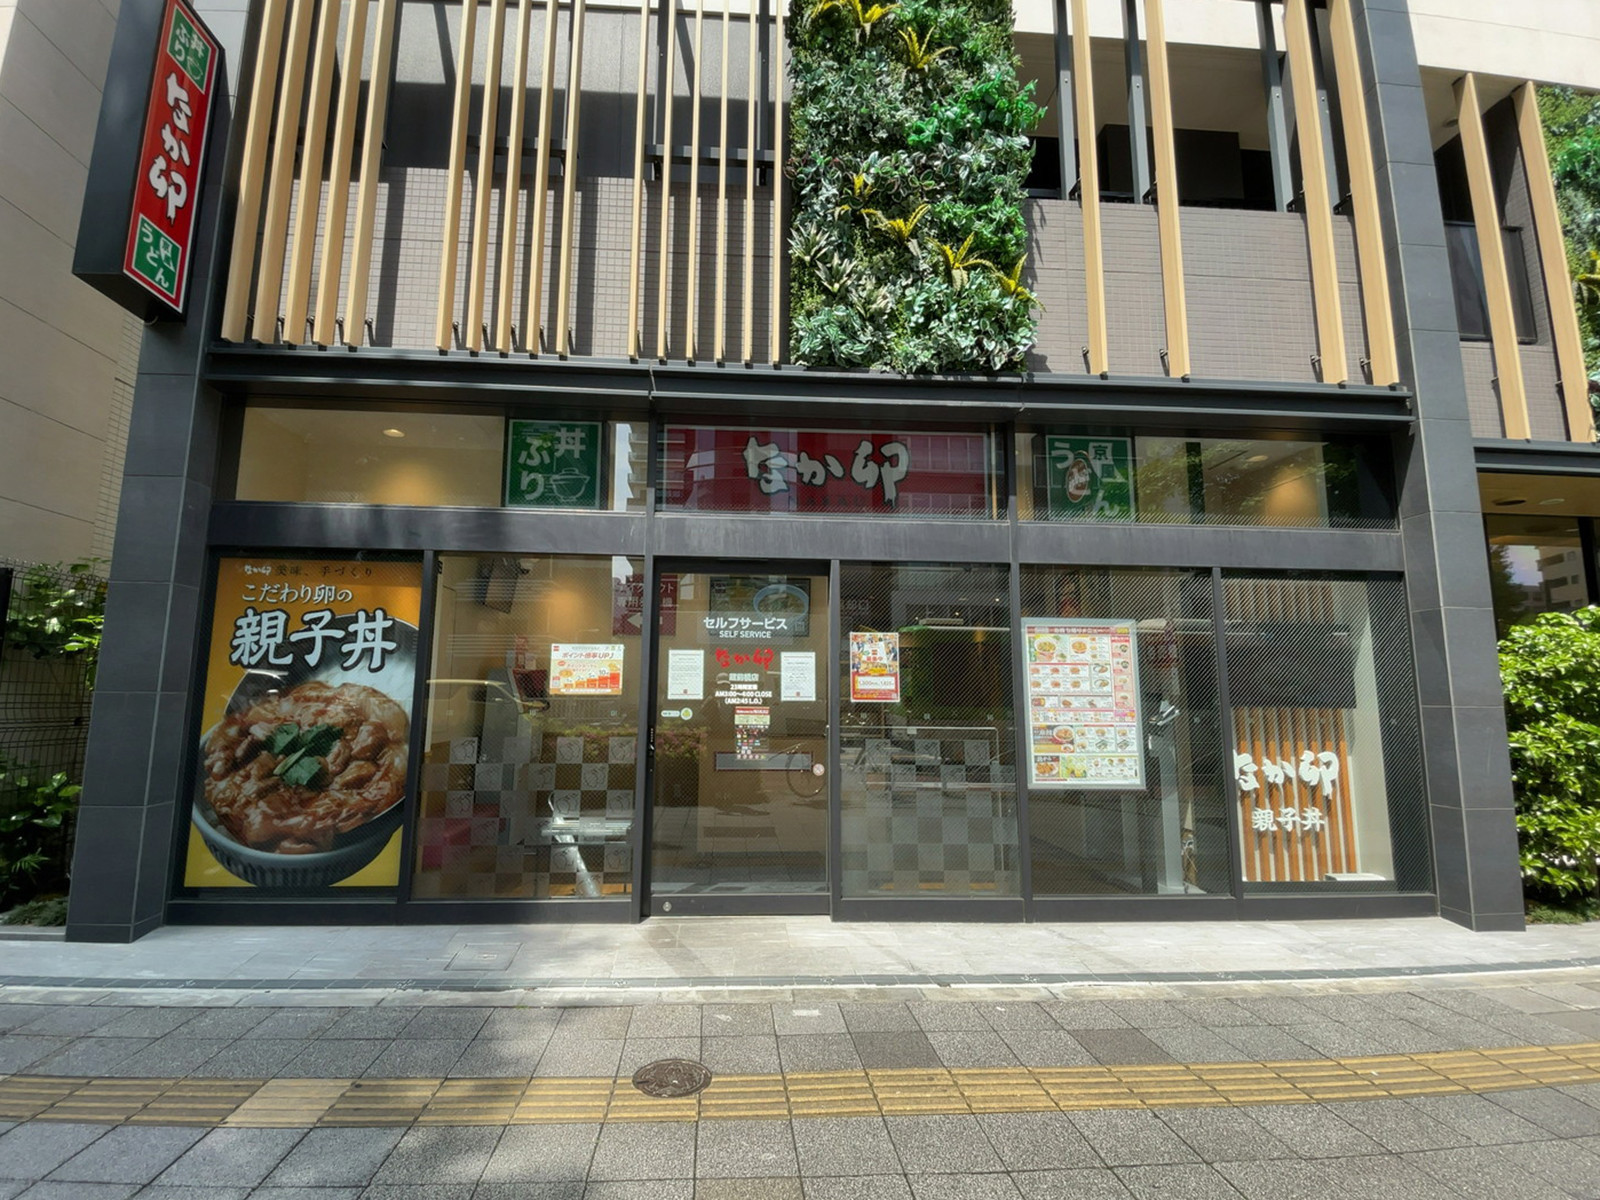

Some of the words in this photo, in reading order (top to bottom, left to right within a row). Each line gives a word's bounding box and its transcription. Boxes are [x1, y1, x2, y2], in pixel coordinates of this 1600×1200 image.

[149, 72, 192, 226] なか卯
[140, 223, 169, 288] うどん
[554, 427, 586, 459] 丼
[517, 437, 551, 500] ぶり
[743, 436, 909, 508] なか卯
[242, 583, 353, 605] こだわり卵の
[229, 607, 398, 670] 親子丼
[703, 616, 788, 630] セルフサービス
[719, 631, 738, 639] SELF
[740, 631, 772, 639] SERVICE
[715, 648, 775, 669] なか卯
[1232, 749, 1340, 799] なか卯
[1252, 806, 1326, 832] 親子丼
